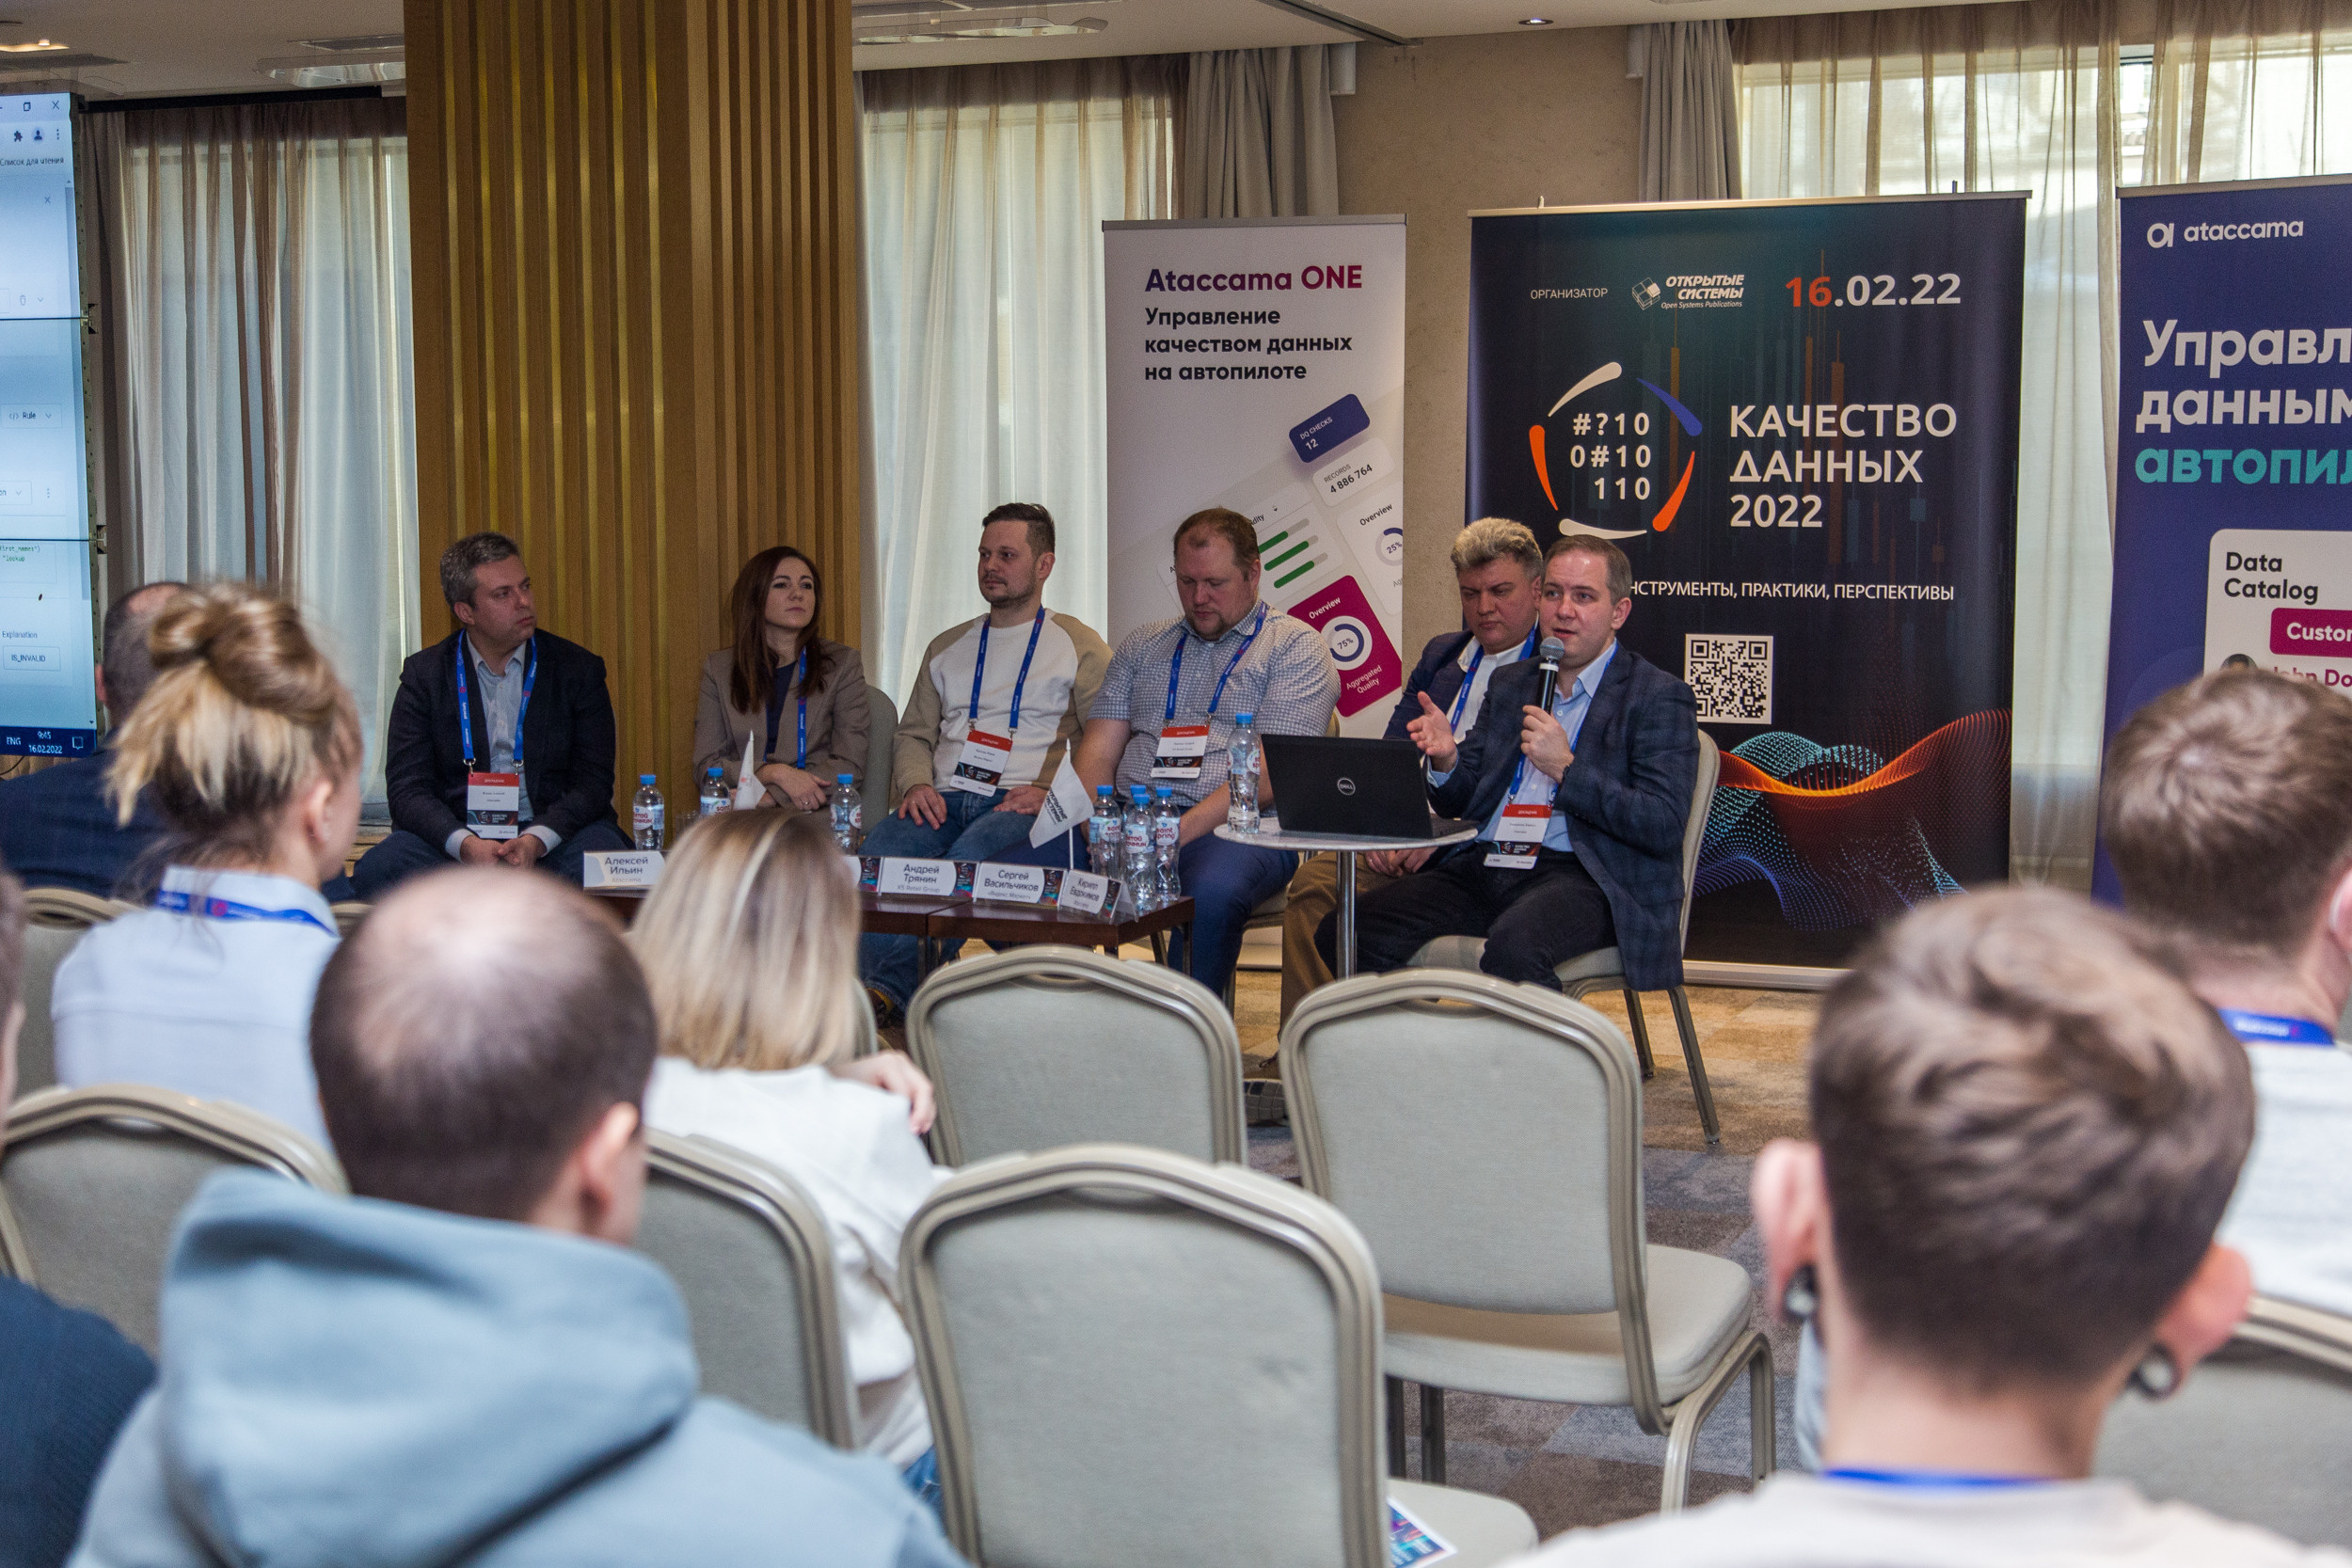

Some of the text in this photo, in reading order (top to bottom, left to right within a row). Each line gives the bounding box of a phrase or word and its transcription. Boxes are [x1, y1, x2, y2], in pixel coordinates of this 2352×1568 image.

[2184, 220, 2304, 243] ataccama
[1145, 264, 1362, 293] Ataccama ONE
[1665, 274, 1745, 288] ОТКРЫТЫЕ
[1530, 287, 1609, 300] ОРГАНИЗАТОР
[1677, 287, 1744, 300] СИСТЕМЫ
[1785, 273, 1963, 309] 16.02.22
[1661, 300, 1742, 310] Open Systems Publications
[1145, 307, 1280, 330] Управление
[1145, 337, 1353, 356] качеством данных
[2142, 319, 2352, 379] Управл
[1145, 364, 1307, 381] на автопилоте
[23, 411, 37, 420] Rule
[1729, 403, 1958, 438] КАЧЕСТВО
[1299, 416, 1333, 440] DQ CHECKS
[1305, 438, 1319, 451] 12
[1324, 464, 1352, 484] RECORDS
[1729, 449, 1924, 483] ДАННЫХ
[1329, 464, 1374, 495] 4 886 764
[1594, 476, 1651, 501] 110
[1359, 503, 1393, 527] Overview
[1729, 494, 1823, 529] 2022
[2226, 551, 2282, 573] Data
[1630, 580, 1955, 601] НСТРУМЕНТЫ, ПРАКТИКИ, ПЕРСПЕКТИВЫ
[2224, 578, 2318, 606] Catalog
[1308, 595, 1342, 620] Overview
[2, 630, 39, 640] Explanation
[1337, 637, 1355, 650] 75%
[11, 654, 46, 663] IS_INVALID
[1345, 664, 1383, 690] Aggregated
[1356, 677, 1380, 694] Quality
[7, 736, 22, 746] ENG
[37, 731, 52, 740] 9:45
[28, 745, 63, 754] 16.02.2022
[1046, 796, 1063, 823] ИСТЕМЫ
[605, 857, 648, 865] Алексей
[903, 863, 940, 876] Андрей
[610, 866, 643, 875] Ильин
[904, 874, 937, 884] Трянин
[997, 869, 1030, 881] Сергей
[984, 879, 1040, 893] Васильчиков
